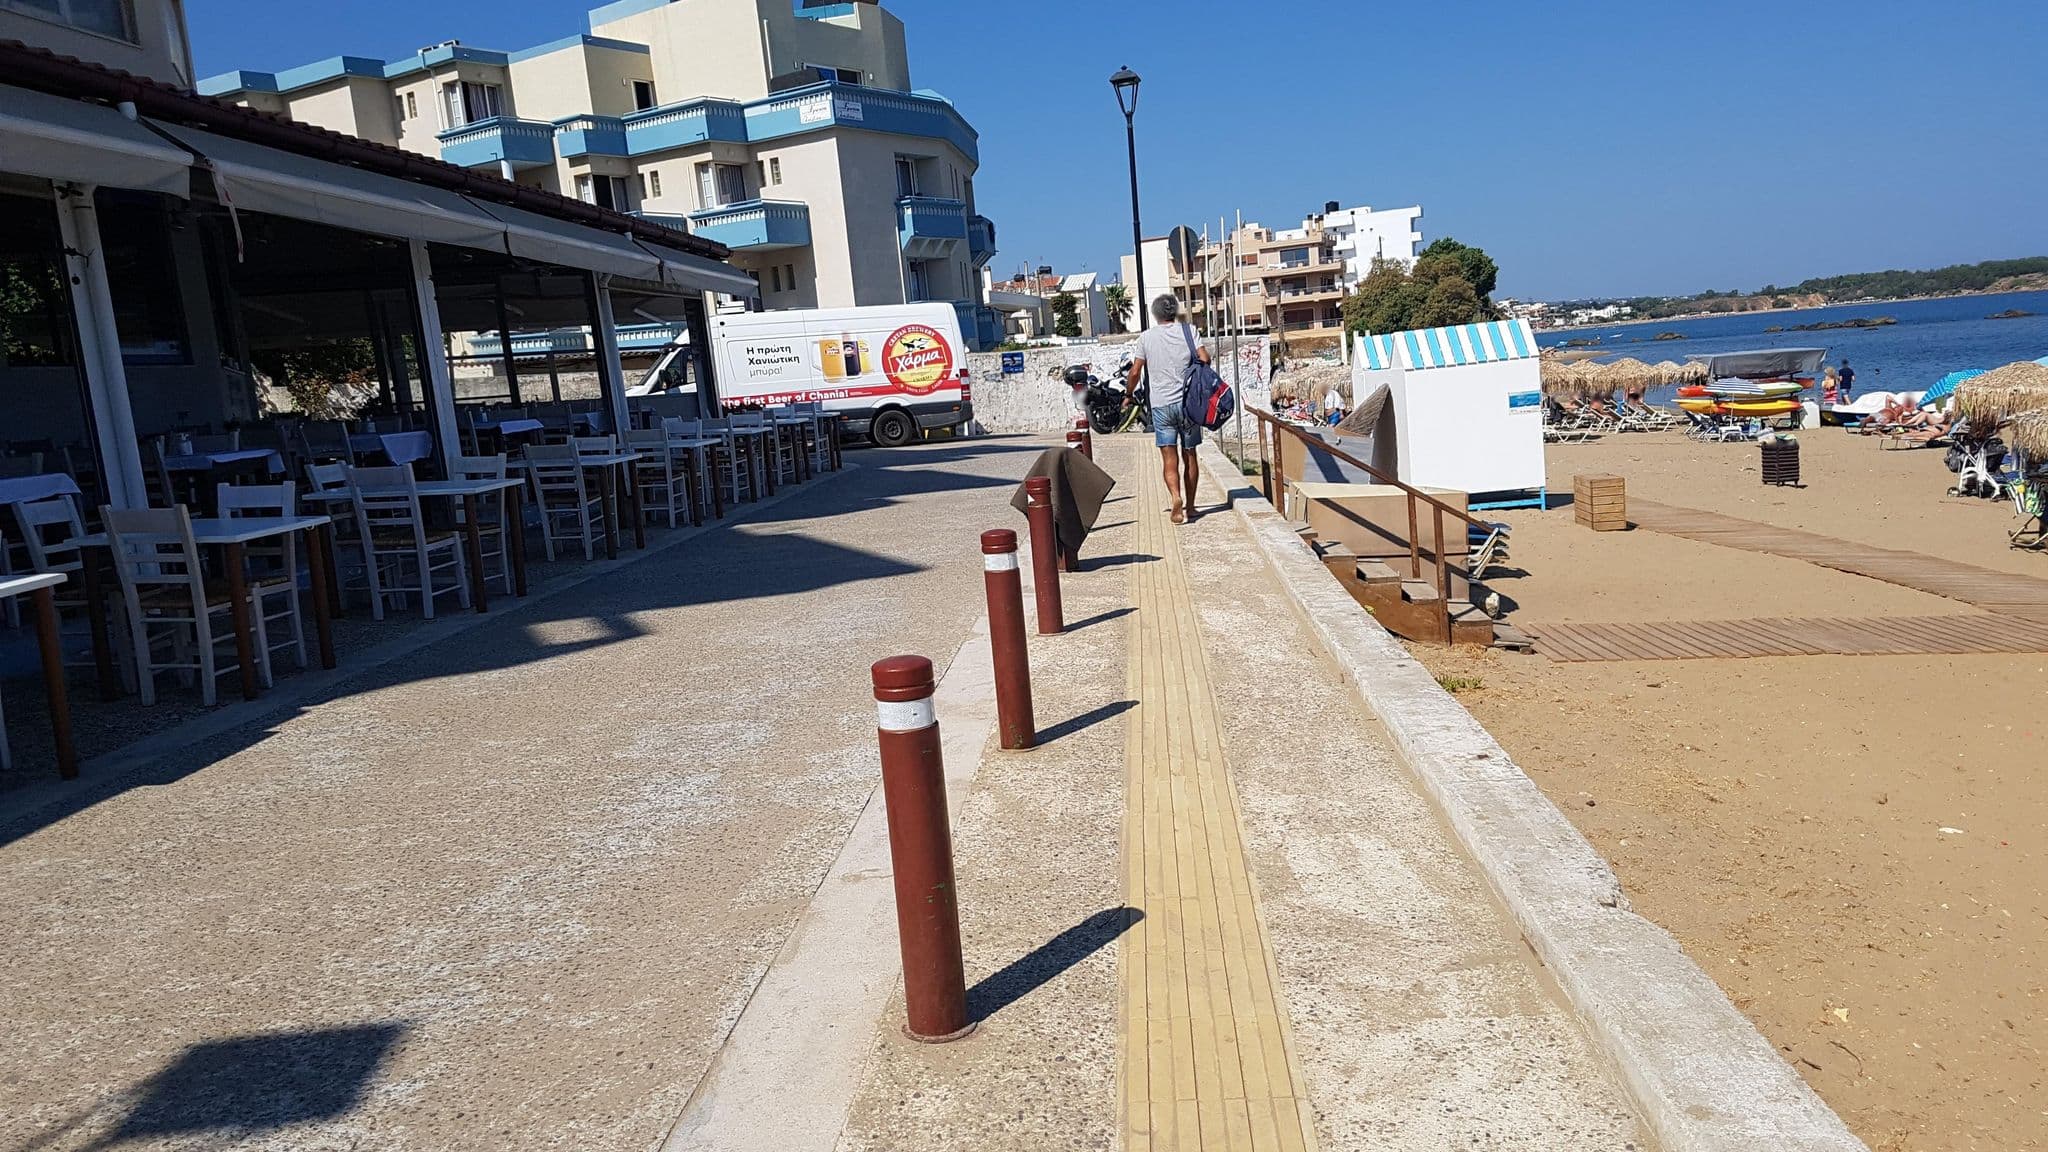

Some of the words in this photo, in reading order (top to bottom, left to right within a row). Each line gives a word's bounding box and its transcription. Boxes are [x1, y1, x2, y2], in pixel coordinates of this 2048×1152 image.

[757, 344, 792, 355] πρώτη
[749, 366, 783, 378] μπύρα!
[743, 396, 766, 406] first
[768, 394, 792, 404] Beer
[796, 392, 806, 402] of
[809, 389, 849, 401] Chania!
